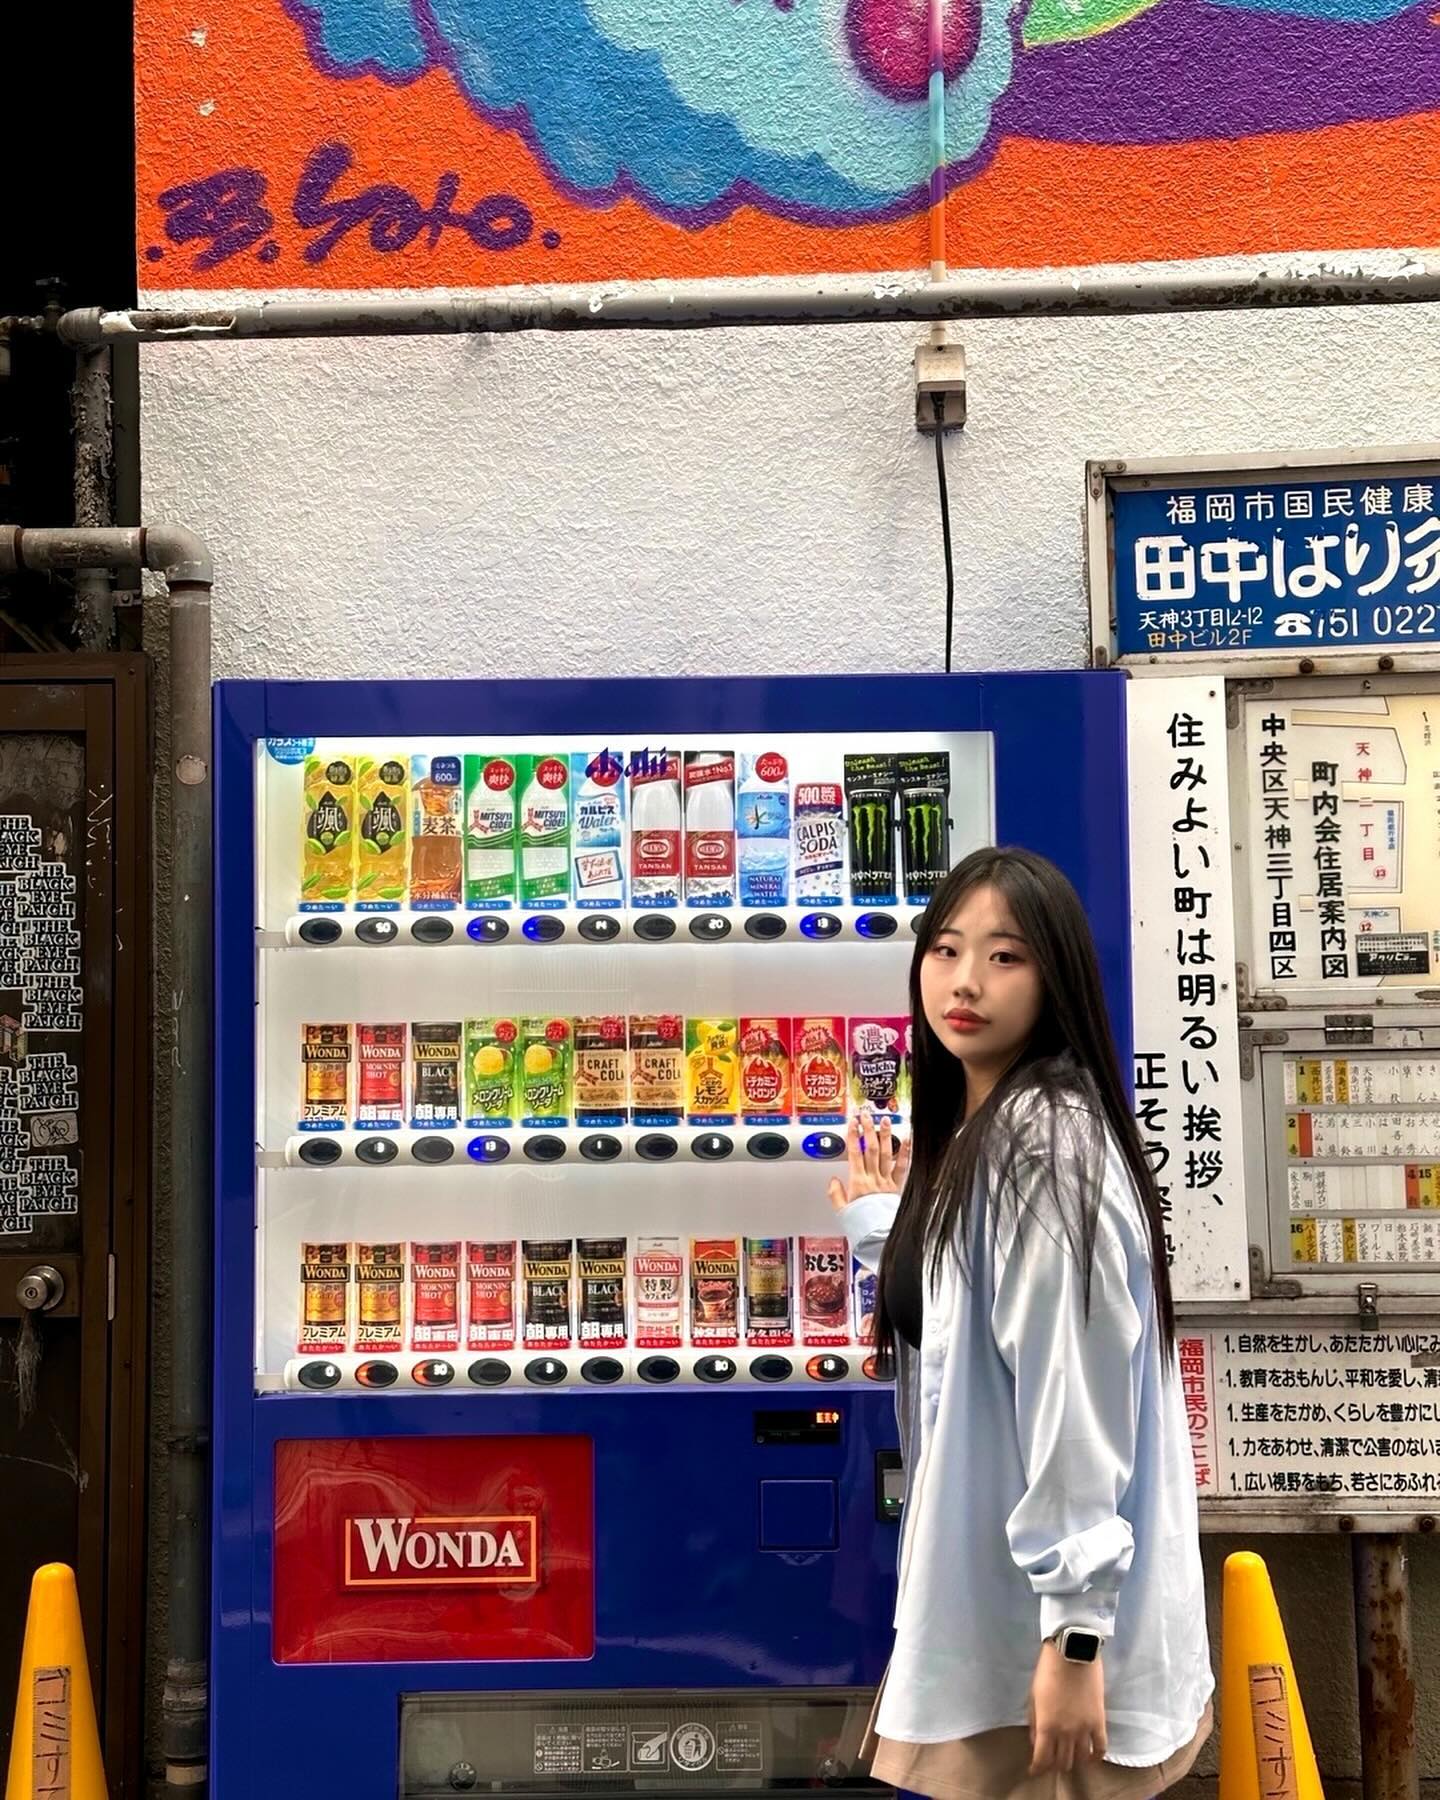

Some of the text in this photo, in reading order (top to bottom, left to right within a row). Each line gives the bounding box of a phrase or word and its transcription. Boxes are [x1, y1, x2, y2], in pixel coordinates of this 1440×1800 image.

[1166, 484, 1434, 526] 福岡市国民健康
[1373, 605, 1440, 636] 022
[1148, 629, 1253, 650] 田中ビル2F
[580, 805, 616, 815] カルピス
[422, 815, 456, 835] 麦茶
[0, 831, 37, 843] ACK
[799, 836, 838, 856] SODA
[1260, 713, 1298, 980] 中央区天神三丁目四区
[0, 857, 36, 868] TCH
[1312, 762, 1349, 979] 町内会住居案内図
[20, 879, 72, 891] BLACK
[31, 891, 60, 903] EYE
[20, 904, 72, 916] PATCH
[33, 921, 67, 933] THE
[24, 934, 76, 946] BLACK
[36, 947, 65, 959] EYE
[24, 960, 76, 972] PATCH
[38, 976, 70, 989] THE
[27, 989, 78, 1001] BLACK
[38, 1002, 67, 1014] EYE
[26, 1015, 77, 1028] PATCH
[305, 1044, 347, 1058] WONDA
[362, 1044, 401, 1058] WONDA
[416, 1043, 457, 1057] WONDA
[30, 1055, 64, 1069] THE
[587, 1058, 619, 1070] CRAFT
[644, 1058, 676, 1068] CRAFT
[21, 1069, 73, 1082] BLACK
[421, 1067, 454, 1078] BLACK
[33, 1082, 62, 1095] EYE
[696, 1086, 728, 1096] レモン
[22, 1094, 73, 1108] PATCH
[693, 1096, 730, 1105] スカッシュ
[31, 1158, 64, 1171] THE
[21, 1172, 73, 1184] BLACK
[1419, 1169, 1432, 1179] 15
[33, 1185, 61, 1197] EYE
[21, 1198, 73, 1211] PATCH
[1290, 1224, 1304, 1233] 16
[304, 1264, 346, 1278] WONDA
[358, 1265, 400, 1278] WONDA
[414, 1264, 456, 1278] WONDA
[470, 1264, 511, 1277] WONDA
[527, 1263, 568, 1276] WONDA
[582, 1260, 623, 1274] WONDA
[637, 1259, 679, 1272] WONDA
[695, 1260, 736, 1274] WONDA
[532, 1286, 566, 1297] BLACK
[587, 1283, 620, 1295] BLACK
[645, 1278, 673, 1292] 特製
[1226, 1368, 1440, 1389] 1.教育をおもんじ、平和を愛し、清
[1231, 1472, 1440, 1492] 1.広い視野をもち、若さにあふれ
[354, 1518, 525, 1573] WONDA
